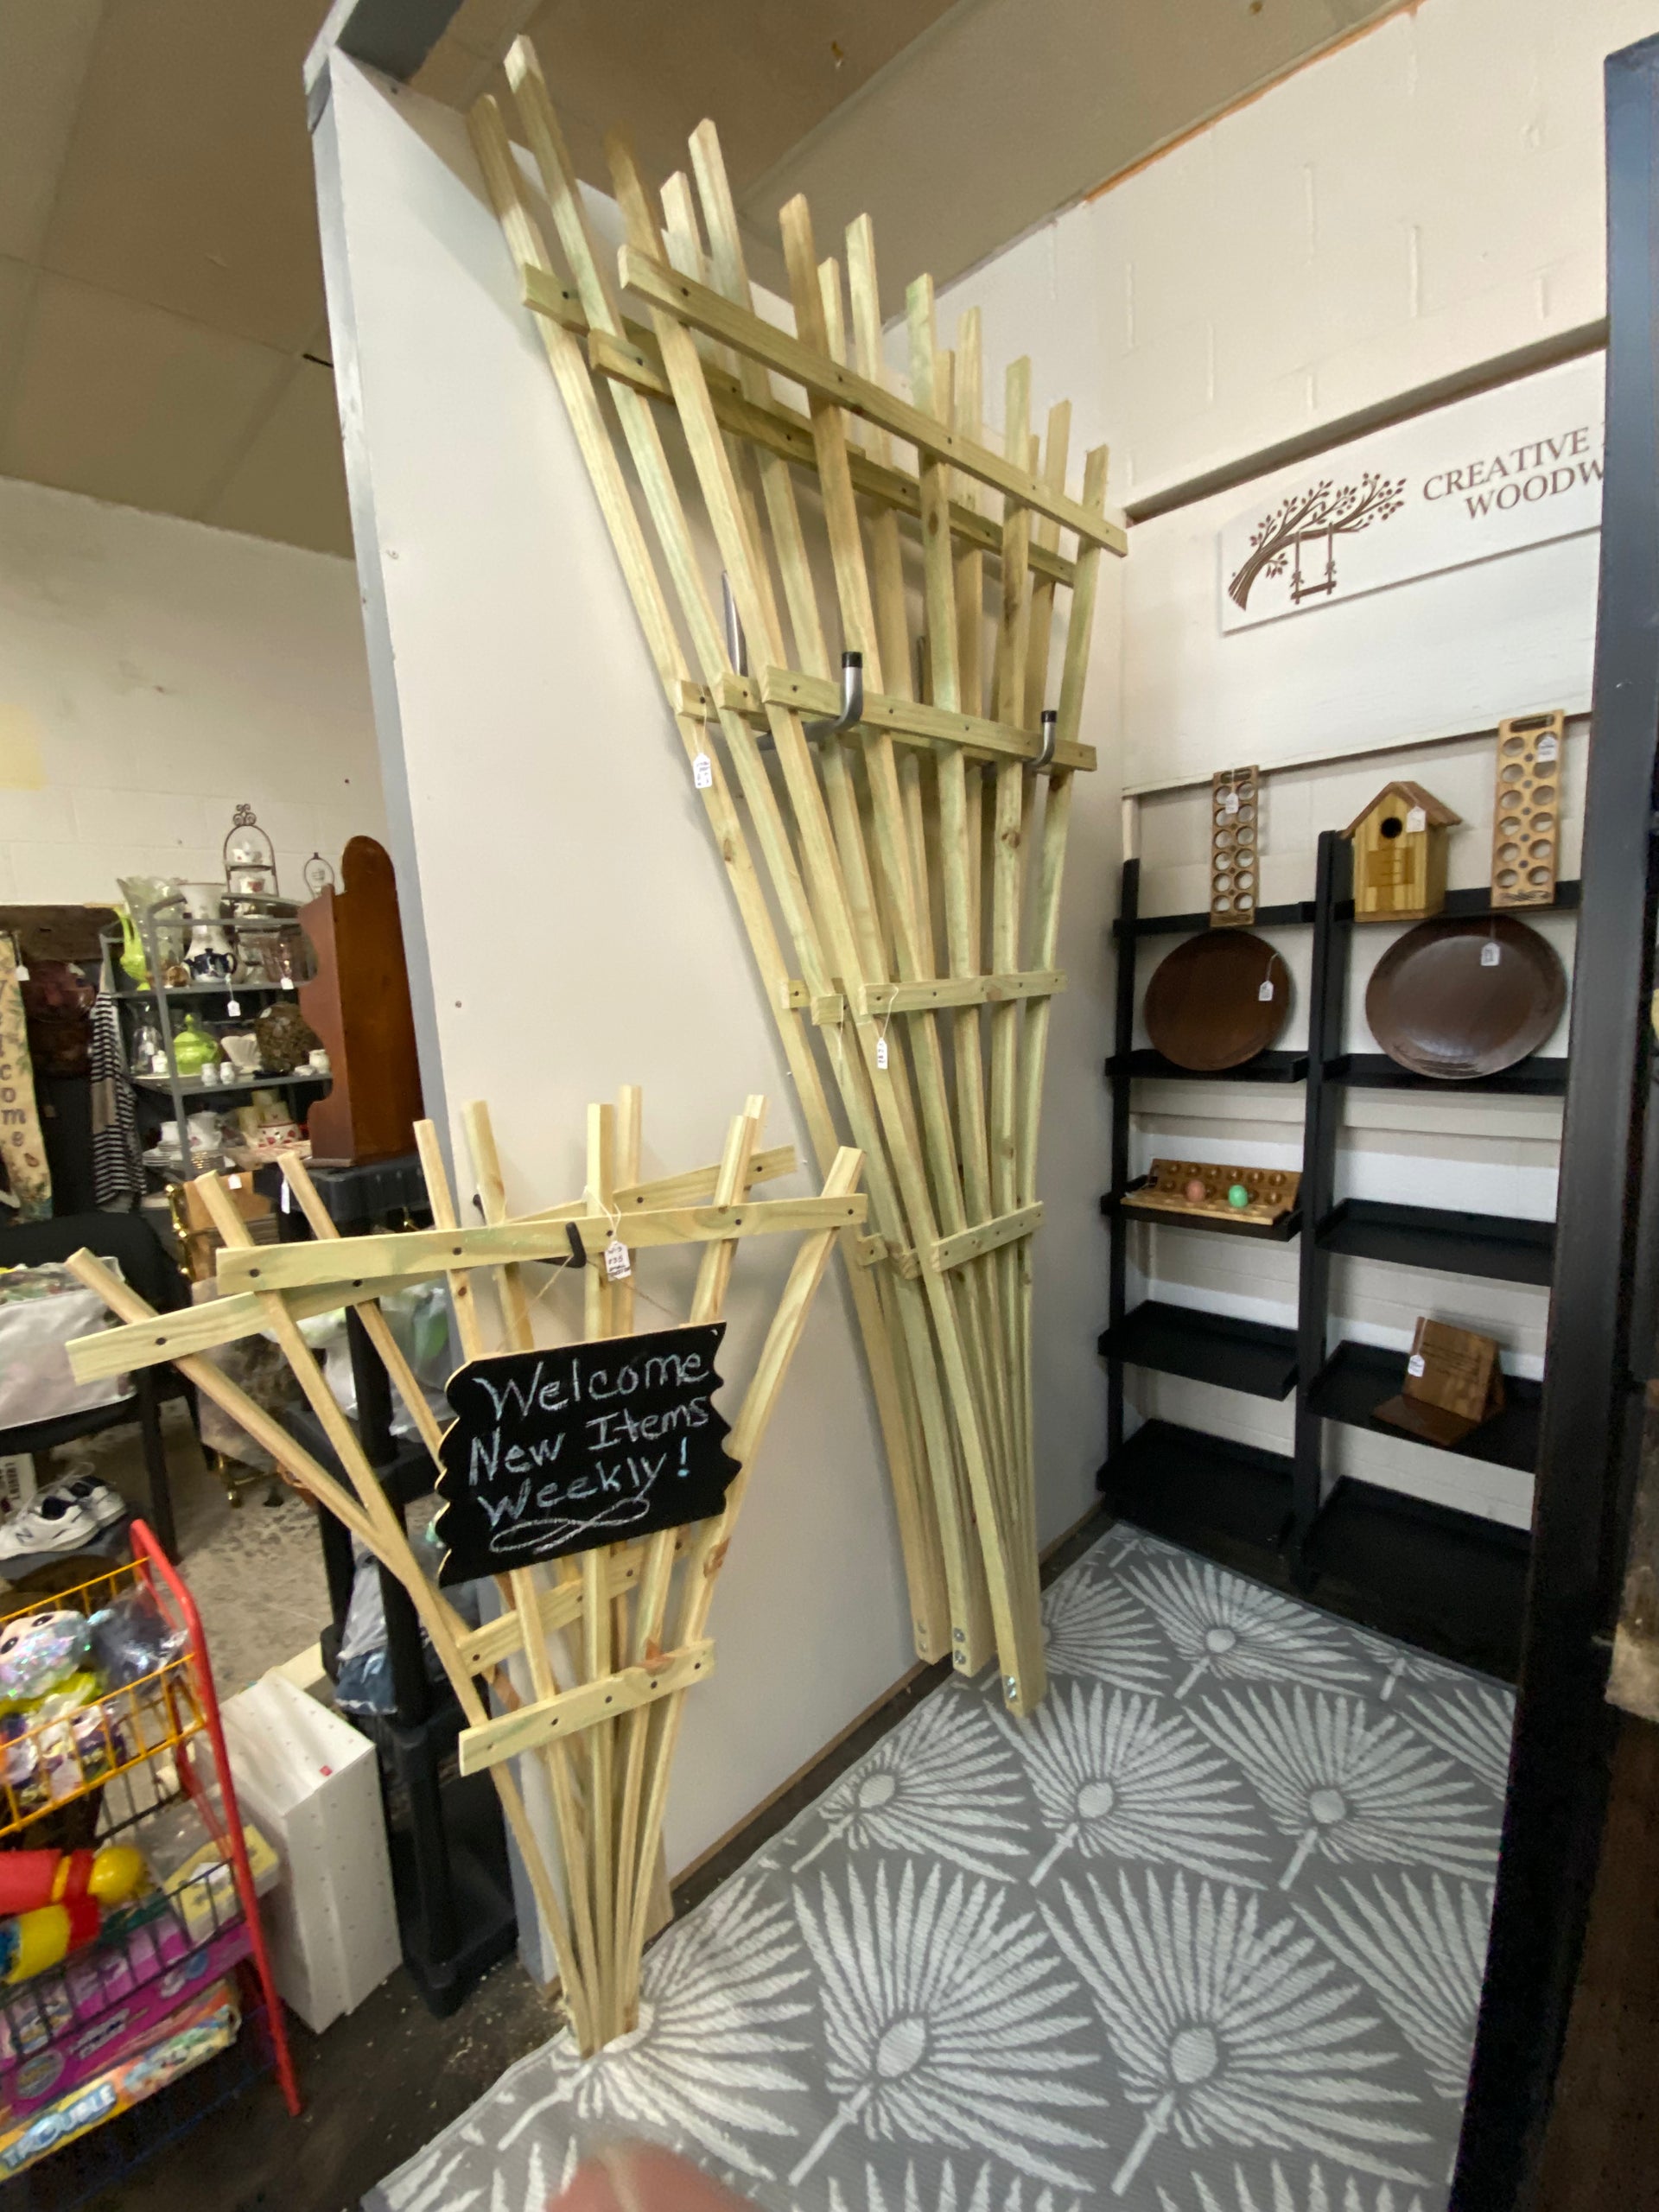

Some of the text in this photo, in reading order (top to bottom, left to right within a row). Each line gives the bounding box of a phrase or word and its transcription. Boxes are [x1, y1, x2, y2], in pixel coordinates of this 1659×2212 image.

[1423, 427, 1590, 501] CREATIVE
[473, 1352, 709, 1421] Welcome
[468, 1396, 709, 1486] New Items
[3, 2082, 115, 2165] TROUBLE
